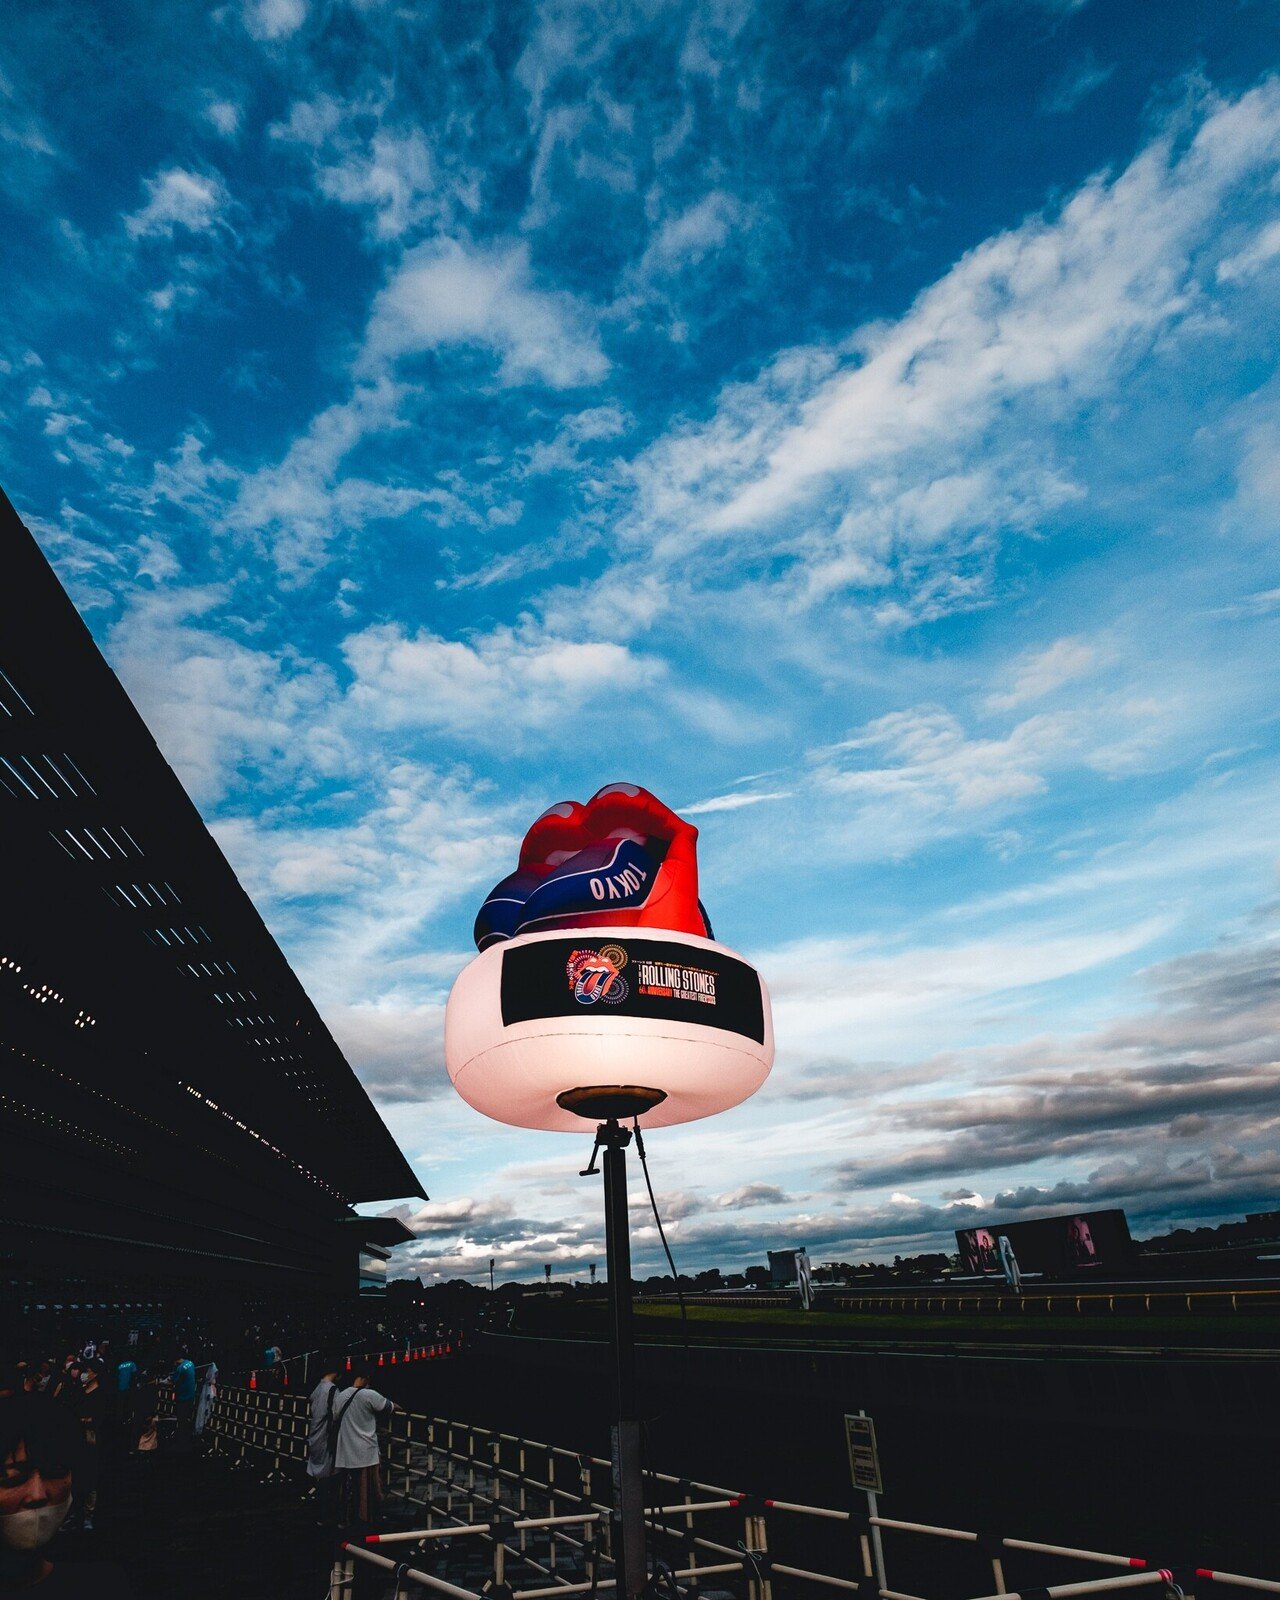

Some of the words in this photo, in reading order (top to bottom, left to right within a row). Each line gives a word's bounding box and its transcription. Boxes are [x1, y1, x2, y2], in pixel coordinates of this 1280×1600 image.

[589, 862, 647, 900] TOKYO
[641, 964, 681, 989] ROLLING
[682, 970, 716, 996] STONES
